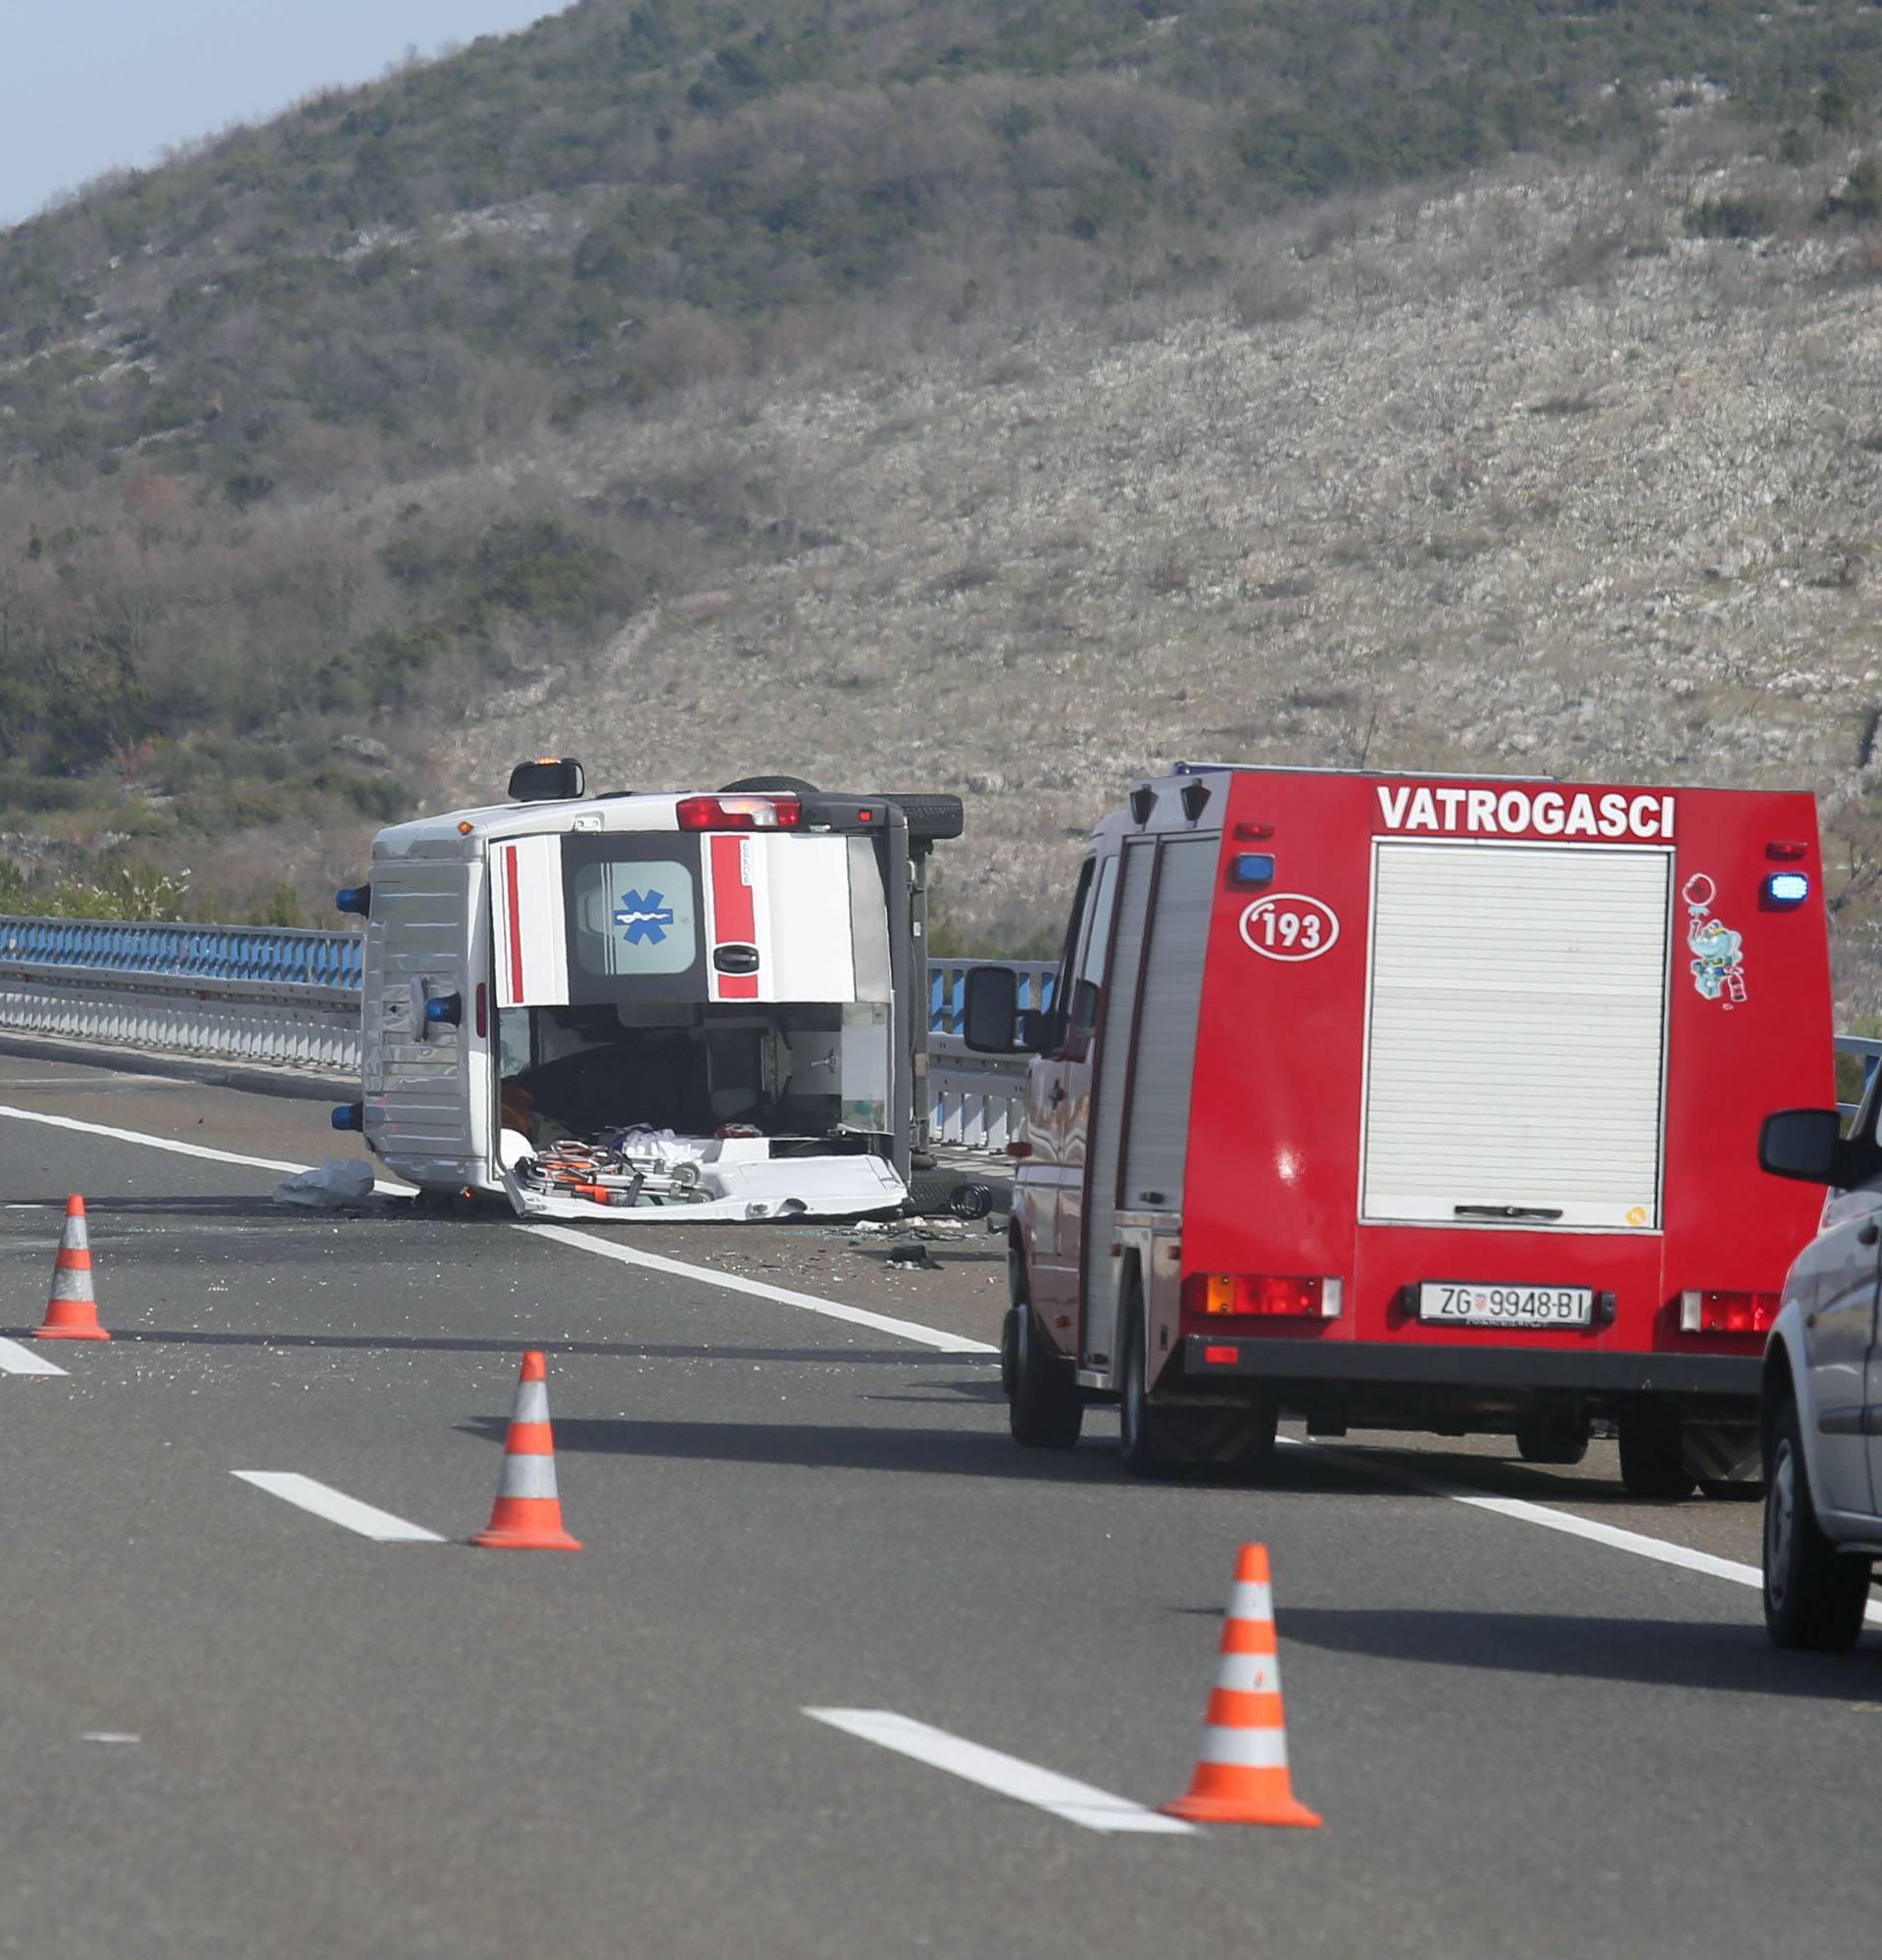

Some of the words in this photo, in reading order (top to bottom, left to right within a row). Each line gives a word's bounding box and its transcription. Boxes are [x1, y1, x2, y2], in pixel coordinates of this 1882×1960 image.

[1376, 786, 1675, 838] VATROGASCI
[1262, 911, 1320, 949] 193
[1441, 1288, 1471, 1314] ZG
